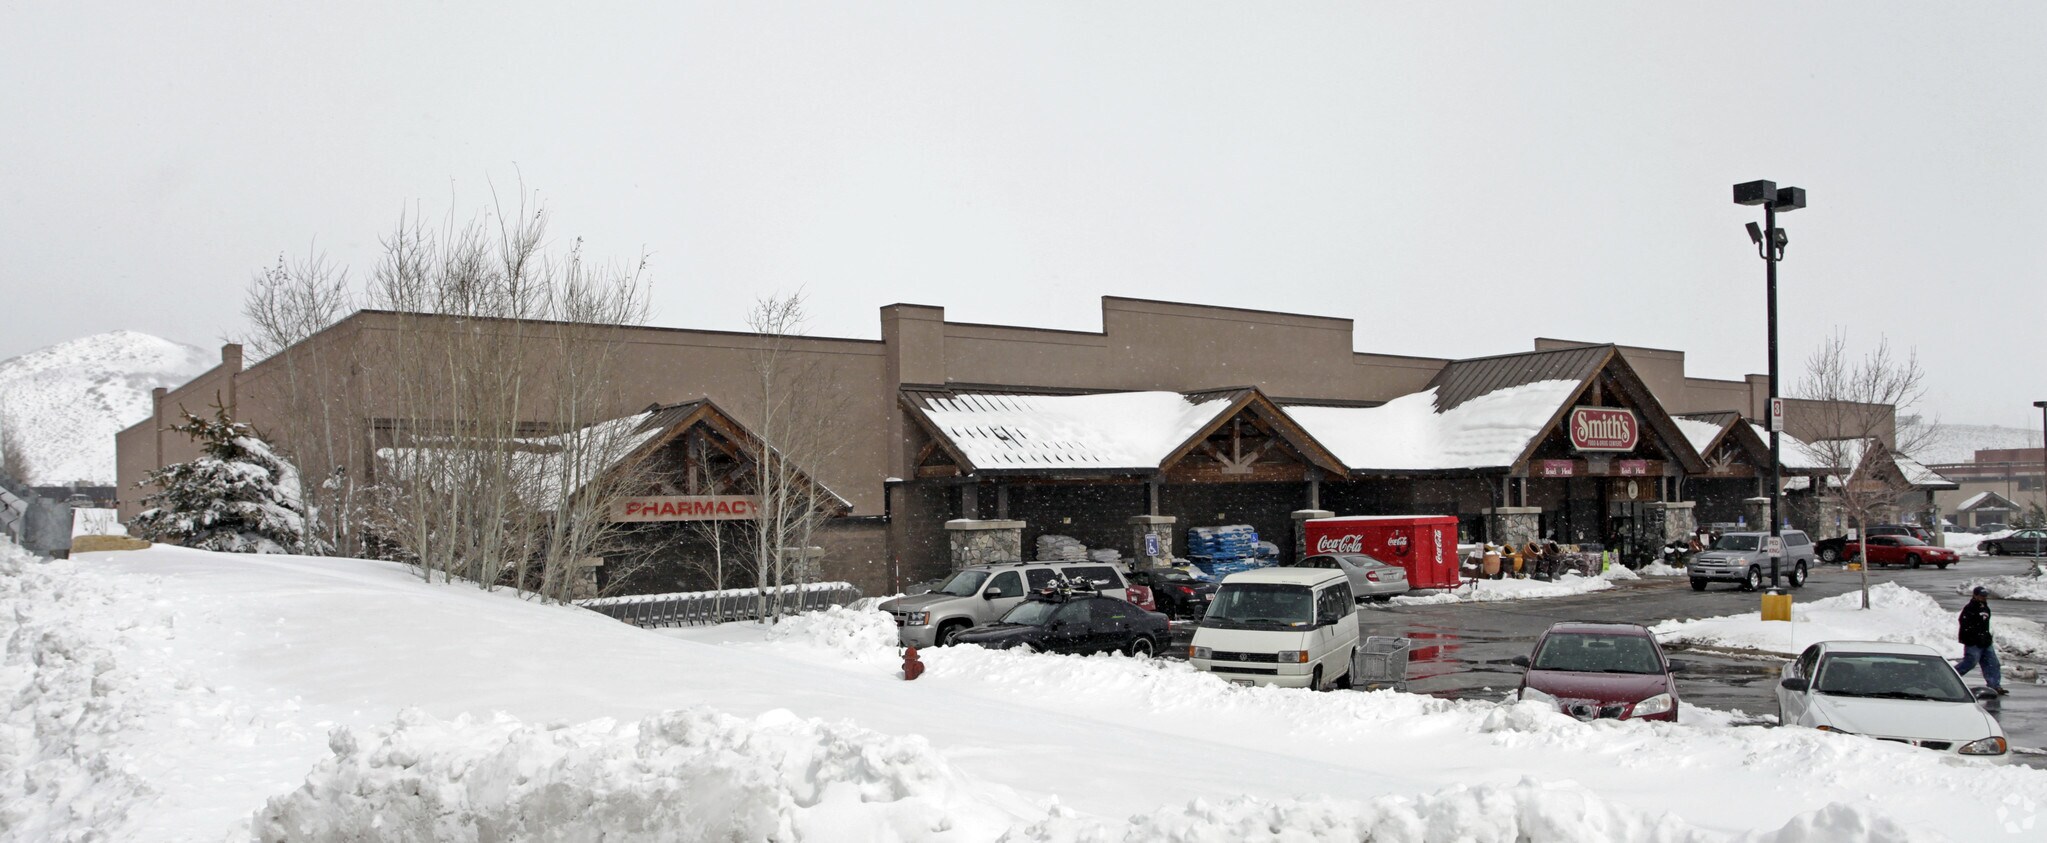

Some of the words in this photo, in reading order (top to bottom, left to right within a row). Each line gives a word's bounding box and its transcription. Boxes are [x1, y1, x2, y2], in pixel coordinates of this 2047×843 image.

[1775, 403, 1780, 415] 3
[1577, 411, 1630, 442] Smith's
[626, 500, 758, 516] PHARMACY
